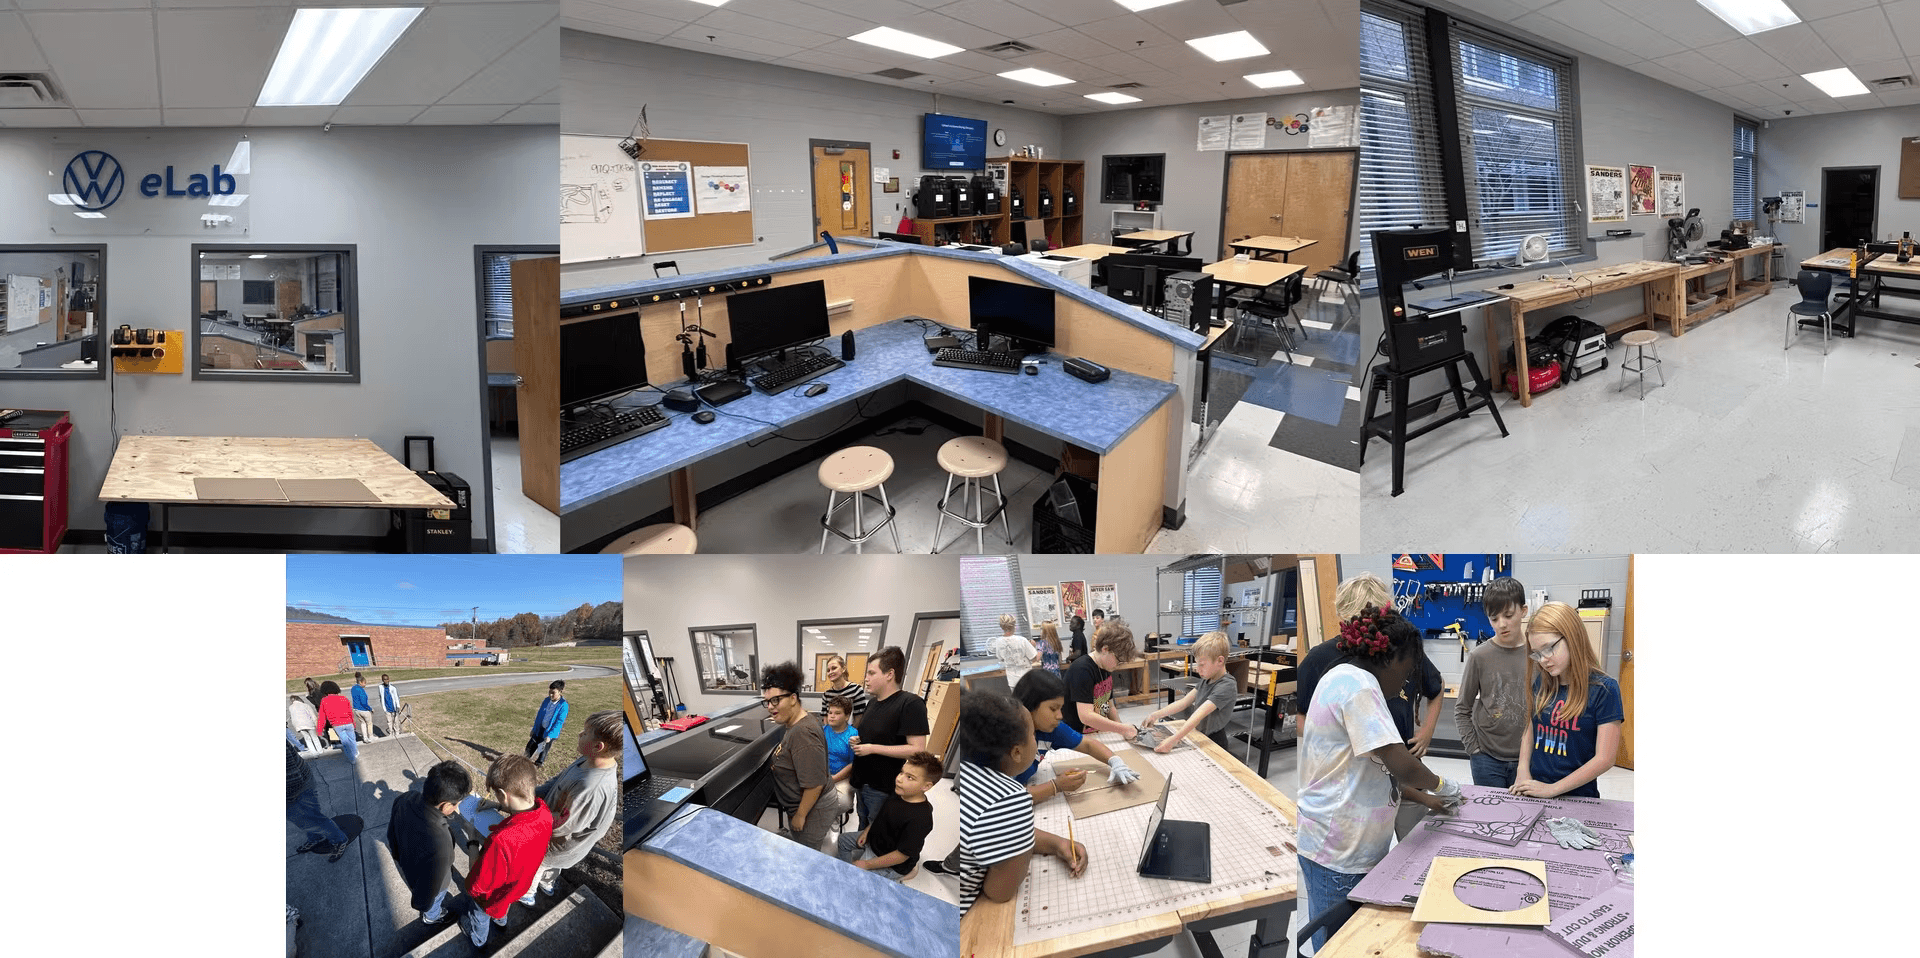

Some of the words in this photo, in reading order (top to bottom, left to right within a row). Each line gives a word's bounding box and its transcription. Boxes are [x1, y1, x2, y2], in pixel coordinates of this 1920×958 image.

[140, 165, 236, 197] eLab
[1590, 170, 1622, 178] SANDERS
[1407, 248, 1434, 257] WEN
[1535, 724, 1568, 756] PWR
[1589, 904, 1612, 920] EASY
[1577, 916, 1594, 926] TO
[1593, 913, 1628, 934] STRONG
[1561, 922, 1581, 936] CUT
[1585, 931, 1598, 939] &
